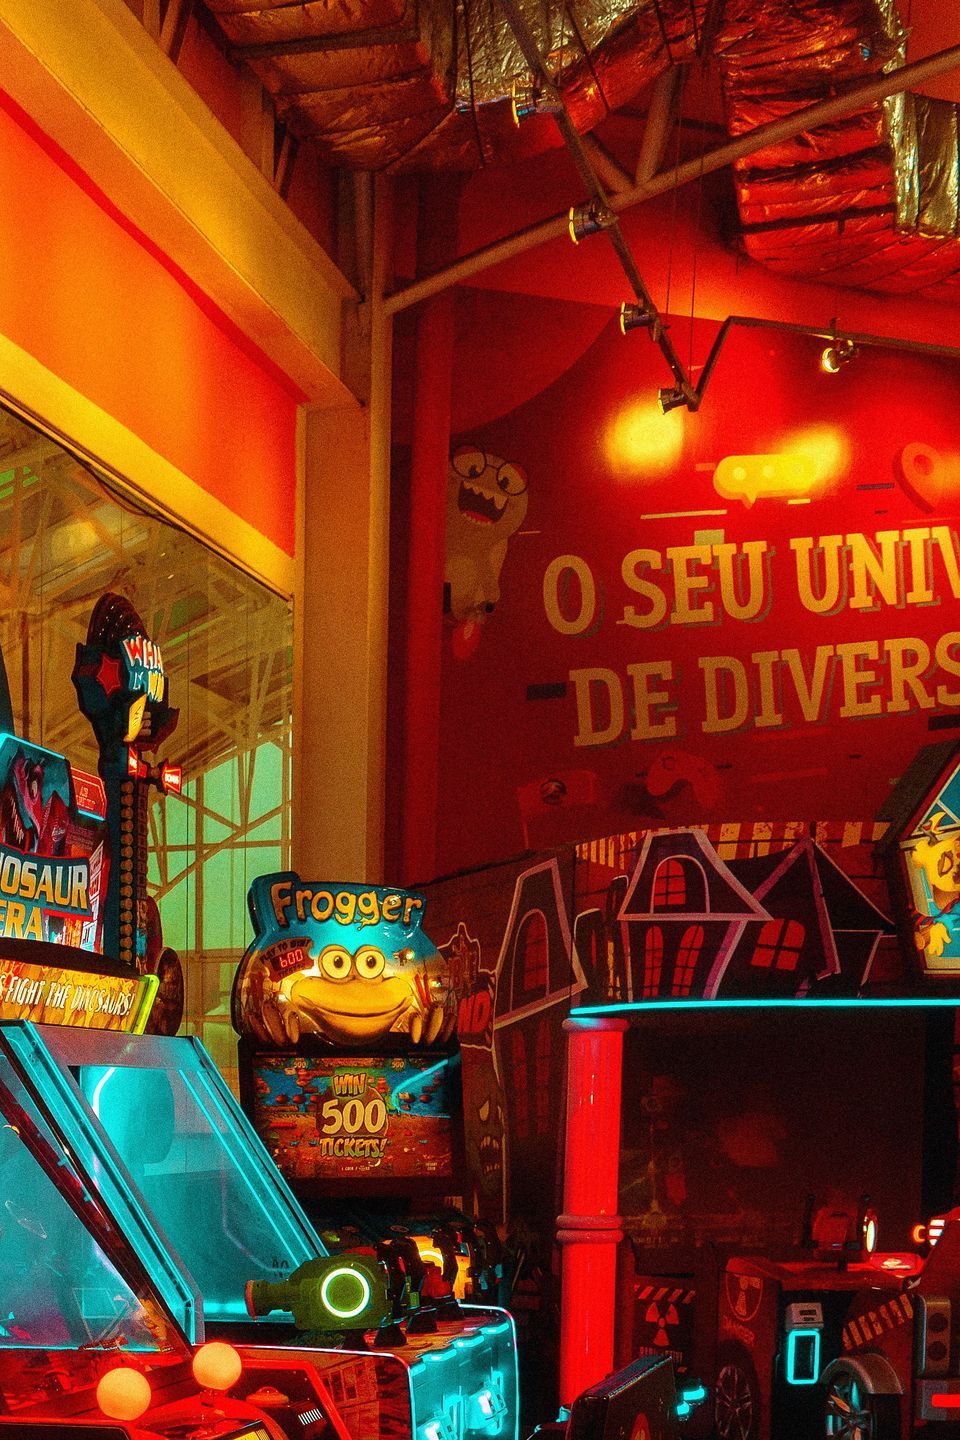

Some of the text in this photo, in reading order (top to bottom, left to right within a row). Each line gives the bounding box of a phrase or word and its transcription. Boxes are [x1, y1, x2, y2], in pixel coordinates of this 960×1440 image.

[543, 554, 598, 636] O
[616, 540, 770, 630] SEU
[569, 659, 678, 747] DE
[270, 881, 424, 930] Frogger
[5, 976, 46, 1006] FIGHT
[46, 982, 72, 1009] THE
[71, 986, 136, 1016] DINOSAURS!
[333, 1073, 367, 1097] WIN
[321, 1099, 387, 1134] 500
[319, 1137, 388, 1158] TICKETS!
